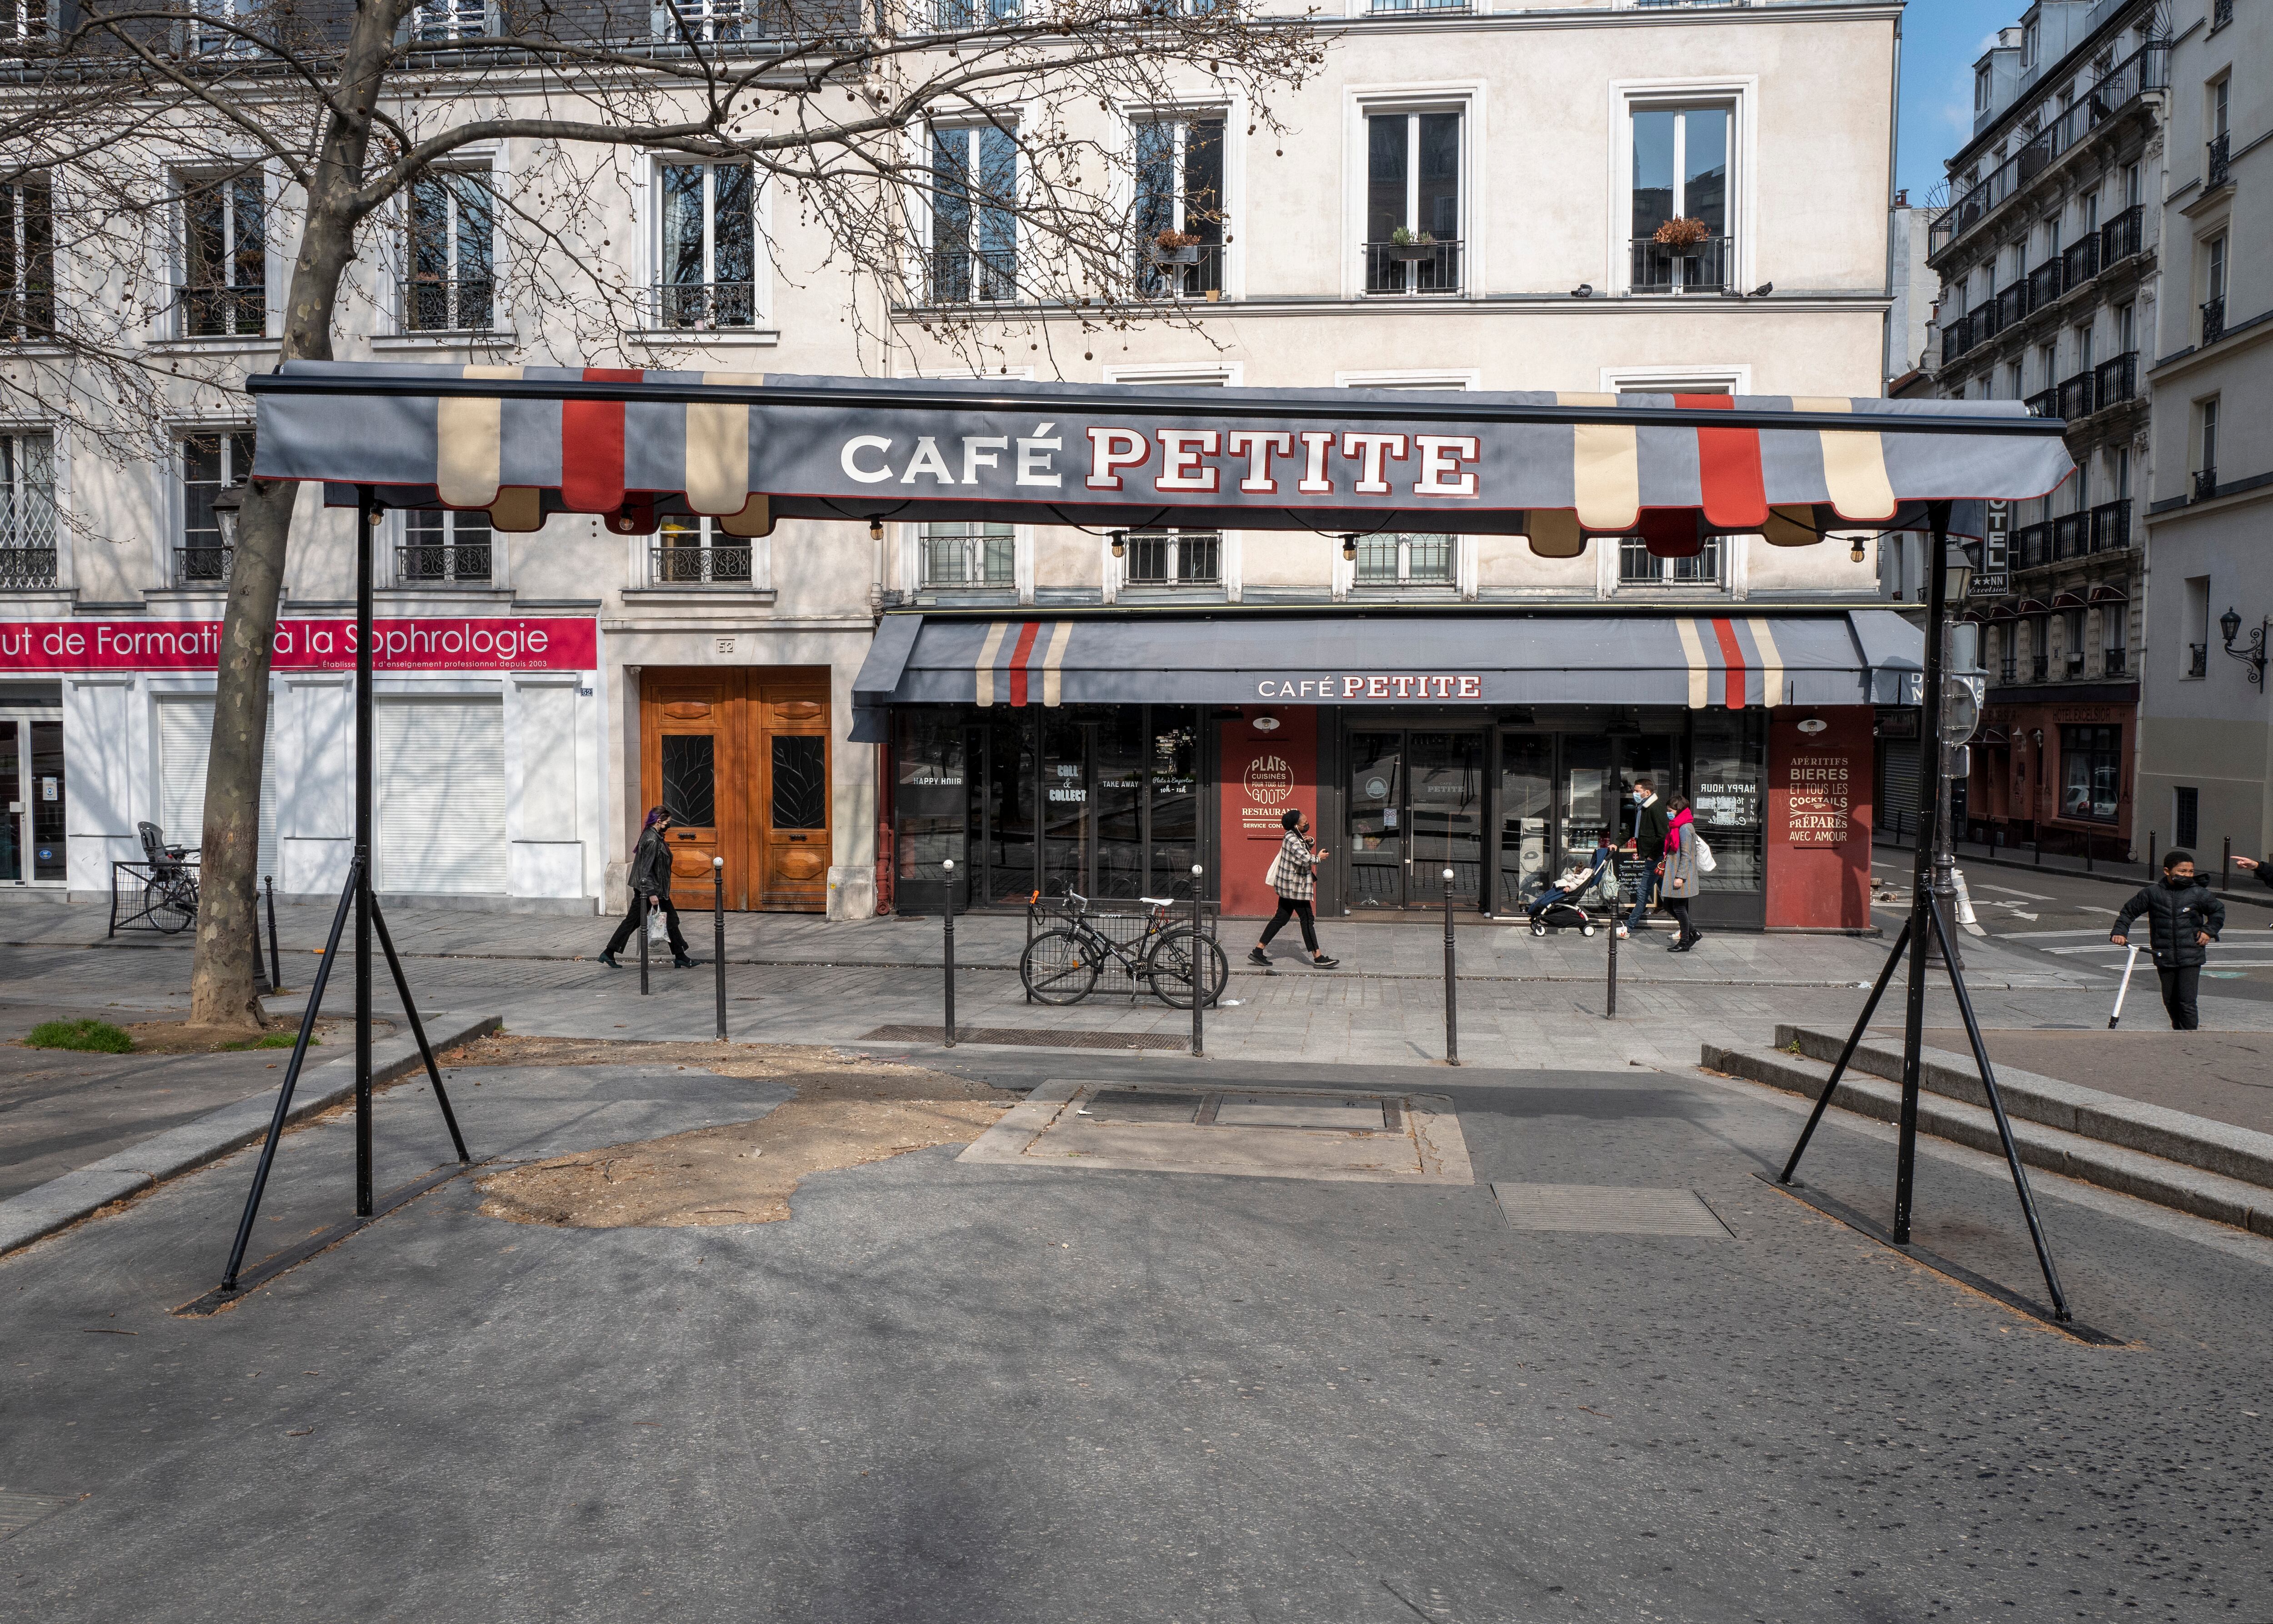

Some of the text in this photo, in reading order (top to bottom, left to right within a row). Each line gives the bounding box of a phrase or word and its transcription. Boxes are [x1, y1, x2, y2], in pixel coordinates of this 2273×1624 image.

[841, 422, 1481, 499] CAFÉ PETITE
[1991, 576, 2003, 586] NN
[43, 627, 85, 655] de
[98, 625, 222, 655] Formati
[273, 623, 292, 653] à
[305, 624, 333, 653] la
[719, 642, 733, 653] 52
[1258, 676, 1482, 699] CAFÉ PETITE
[2053, 707, 2110, 722] HOTEL EXCELSIOR
[1252, 756, 1287, 771] PLATS
[1790, 756, 1848, 765] APÉRITIFS
[1057, 765, 1078, 777] CALL
[1791, 768, 1848, 780] BIERES
[1063, 778, 1072, 788] &
[1171, 777, 1194, 785] Emporter
[1049, 789, 1086, 801] COLLECT
[1160, 785, 1171, 793] 10h
[1176, 785, 1187, 793] 15h
[1790, 783, 1848, 795] ET TOUS LES
[1252, 789, 1286, 804] GOÛTS
[1790, 797, 1848, 808] COCKTAILS
[1789, 814, 1847, 828] PRÉPARÉS
[1789, 832, 1847, 841] AVEC AMOUR
